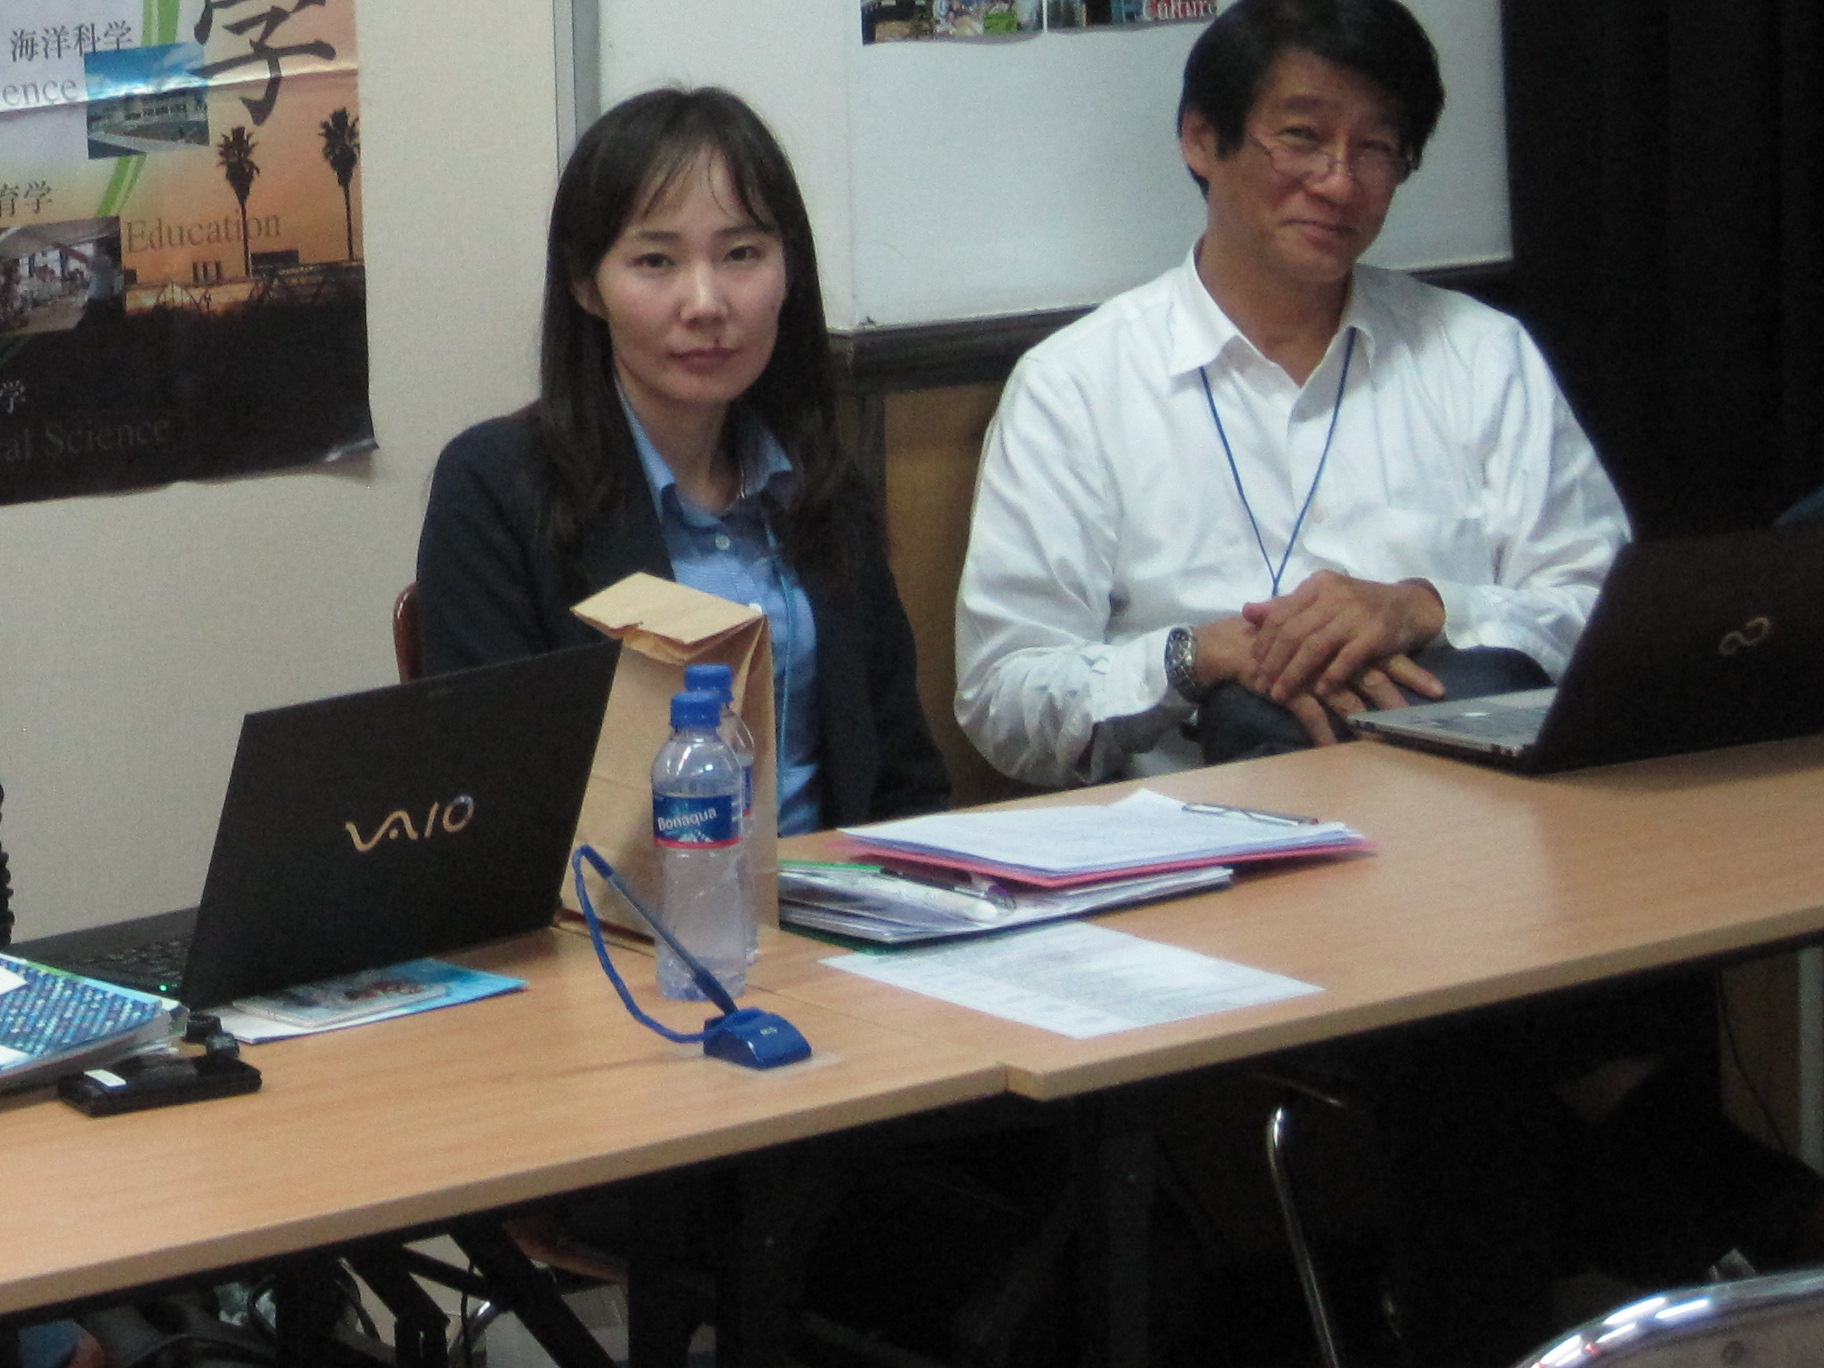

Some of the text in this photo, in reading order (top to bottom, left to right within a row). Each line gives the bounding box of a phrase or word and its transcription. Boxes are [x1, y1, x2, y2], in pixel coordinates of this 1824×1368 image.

[10, 20, 133, 63] 海洋科学
[127, 208, 281, 253] Education
[44, 417, 172, 458] Science
[344, 794, 474, 852] VAIO
[657, 807, 717, 832] Bonaqua
